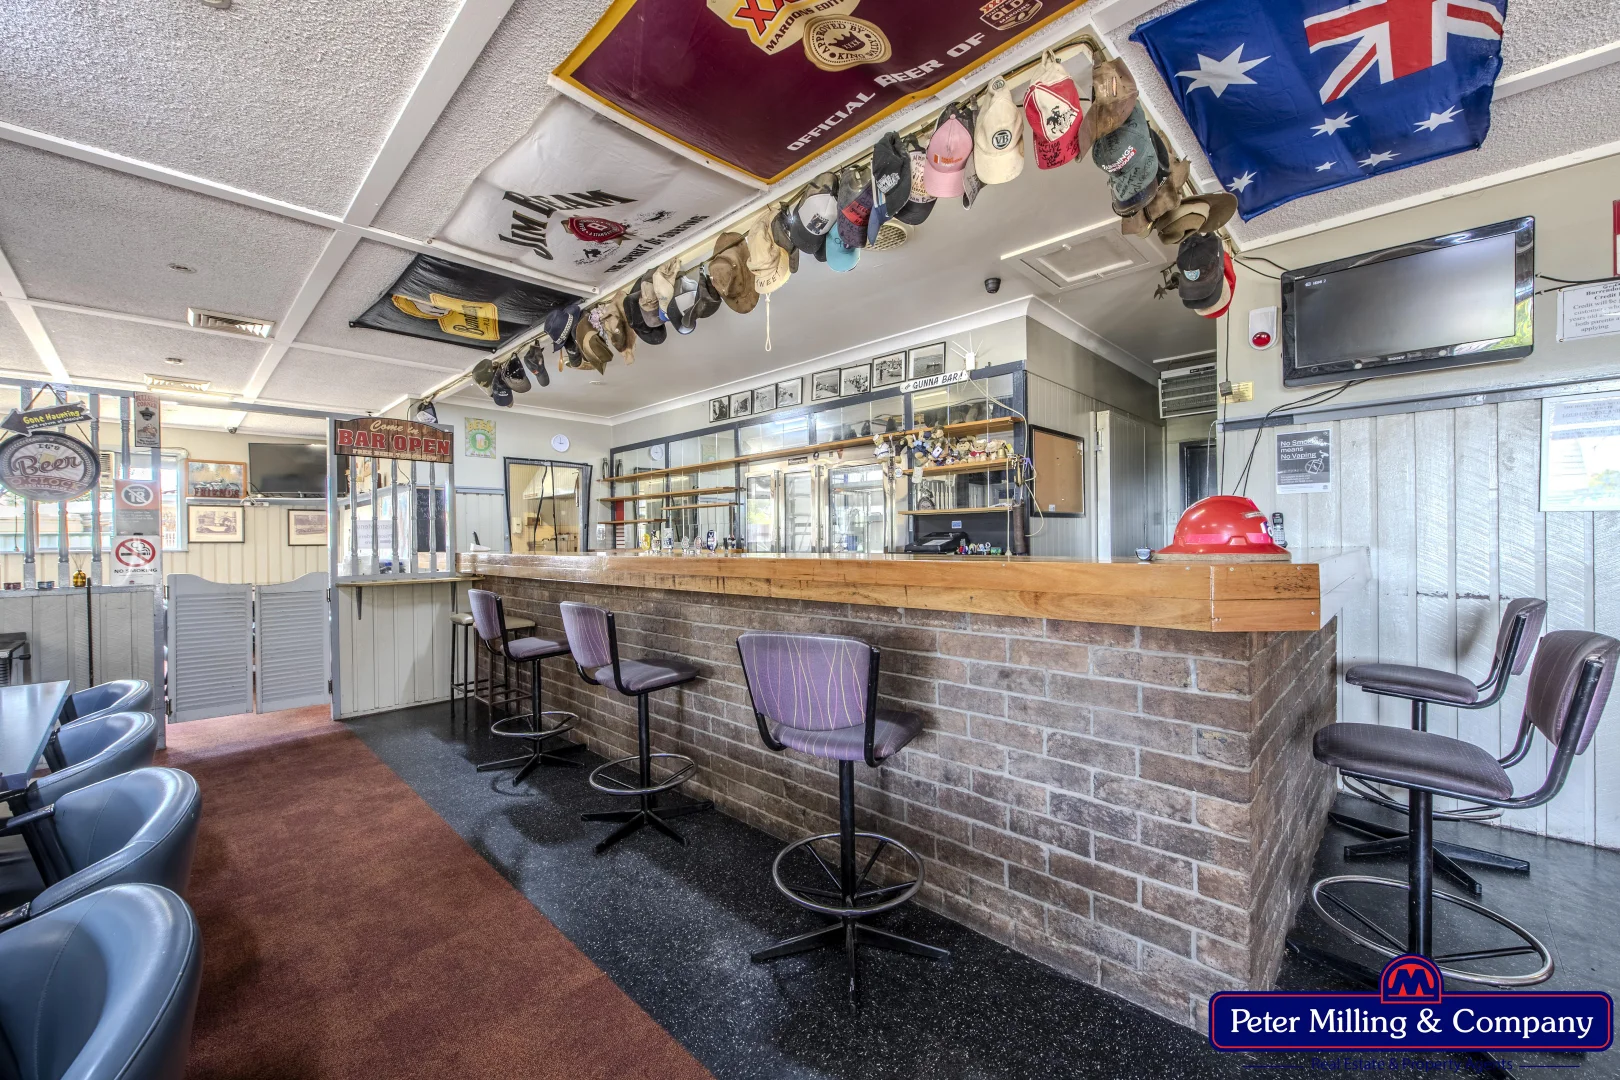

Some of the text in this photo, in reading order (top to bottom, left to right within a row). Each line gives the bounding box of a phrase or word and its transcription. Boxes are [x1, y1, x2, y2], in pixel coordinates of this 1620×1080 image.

[999, 3, 1031, 24] MAROONS
[765, 7, 815, 52] MAROONS
[817, 23, 866, 54] APPROVED BY
[836, 52, 866, 61] KING
[786, 32, 986, 151] OFFICIAL BEER OF
[995, 134, 1009, 145] VB
[498, 189, 639, 260] JIM BEAM
[603, 263, 628, 273] THE
[617, 244, 653, 264] SPIRIT
[644, 237, 667, 245] OF
[1573, 302, 1593, 310] Credit
[1580, 324, 1610, 332] applying
[1591, 317, 1615, 326] parents
[912, 376, 939, 390] GUNNA
[23, 410, 81, 424] Gone Haunting
[369, 420, 420, 435] Come in
[467, 419, 494, 433] BEER
[337, 428, 451, 456] BAR OPEN
[395, 452, 438, 462] TOMORROW
[11, 454, 83, 477] Beer
[128, 491, 146, 503] 18
[194, 487, 240, 498] FRIENDS
